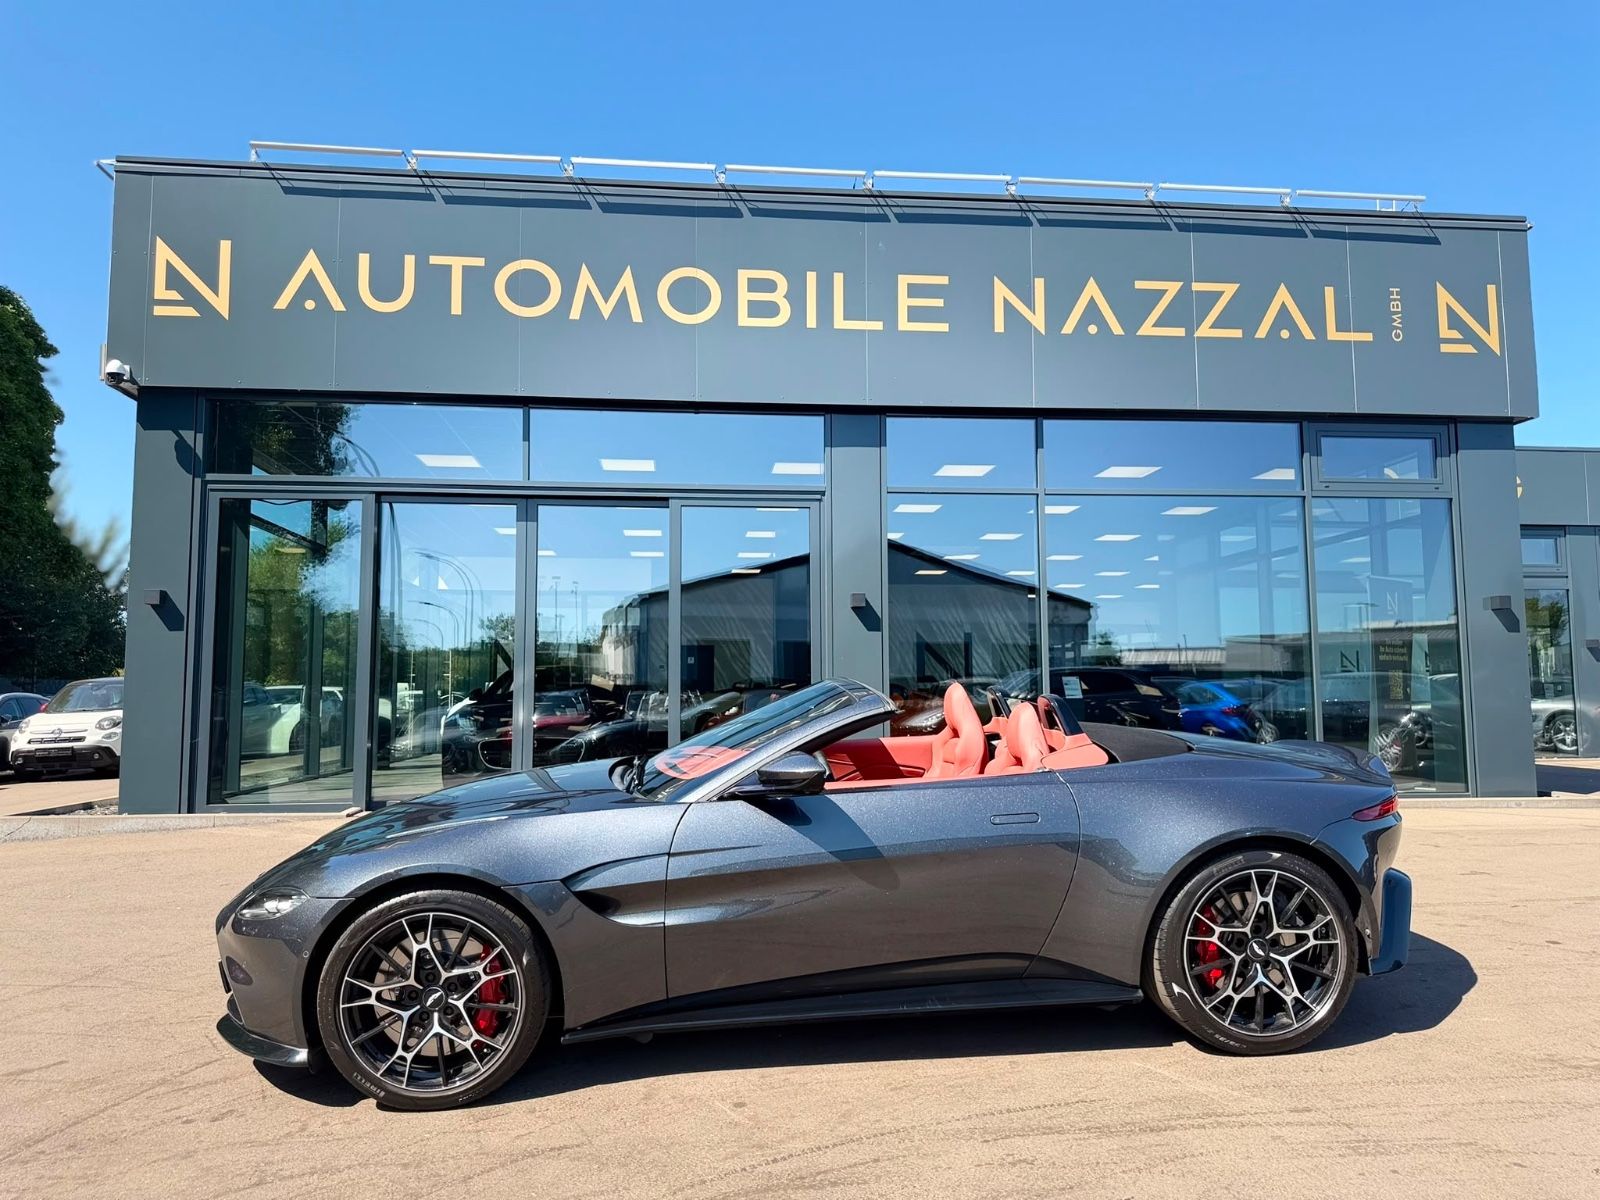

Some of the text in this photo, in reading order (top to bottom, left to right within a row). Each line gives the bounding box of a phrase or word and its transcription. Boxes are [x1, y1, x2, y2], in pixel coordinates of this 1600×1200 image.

[274, 249, 950, 333] AUTOMOBILE
[993, 276, 1374, 343] NAZZAL
[1389, 287, 1403, 342] GMBH
